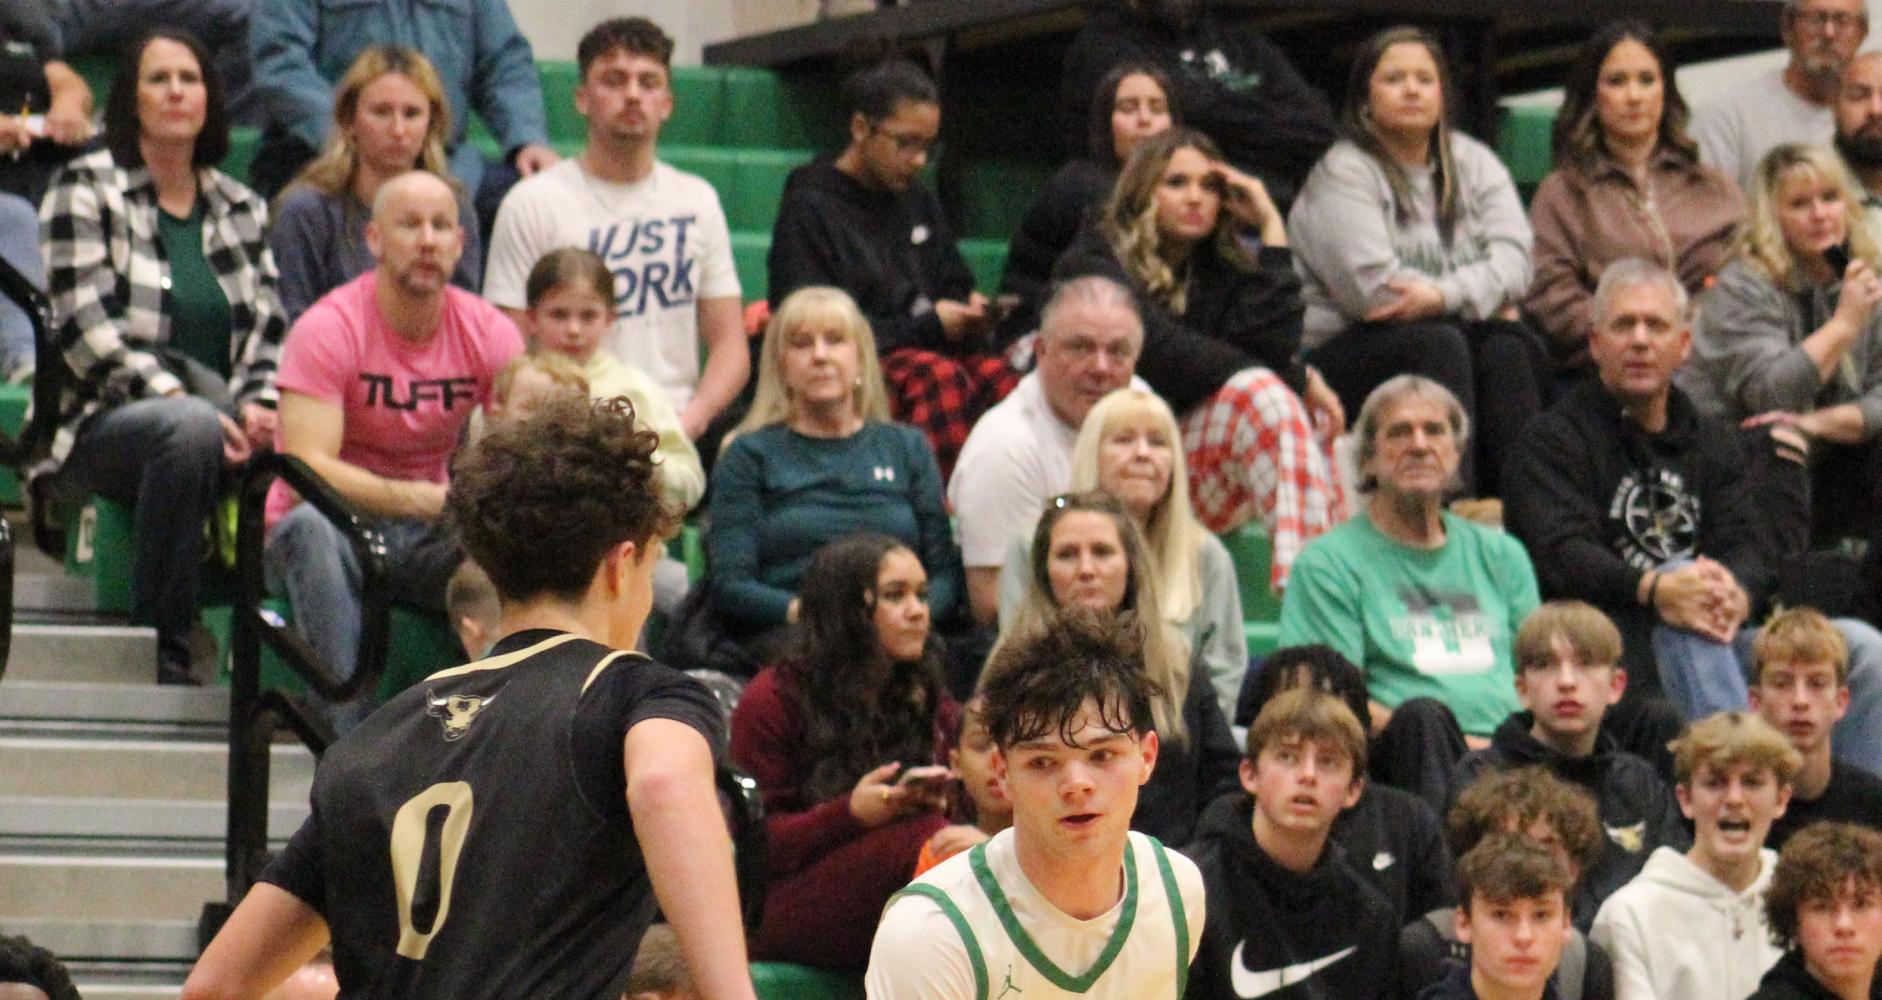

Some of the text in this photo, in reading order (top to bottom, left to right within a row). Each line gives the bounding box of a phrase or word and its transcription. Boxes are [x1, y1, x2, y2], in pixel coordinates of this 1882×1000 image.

[612, 257, 694, 315] ORK
[358, 372, 478, 411] TUFF
[390, 780, 475, 961] 0
